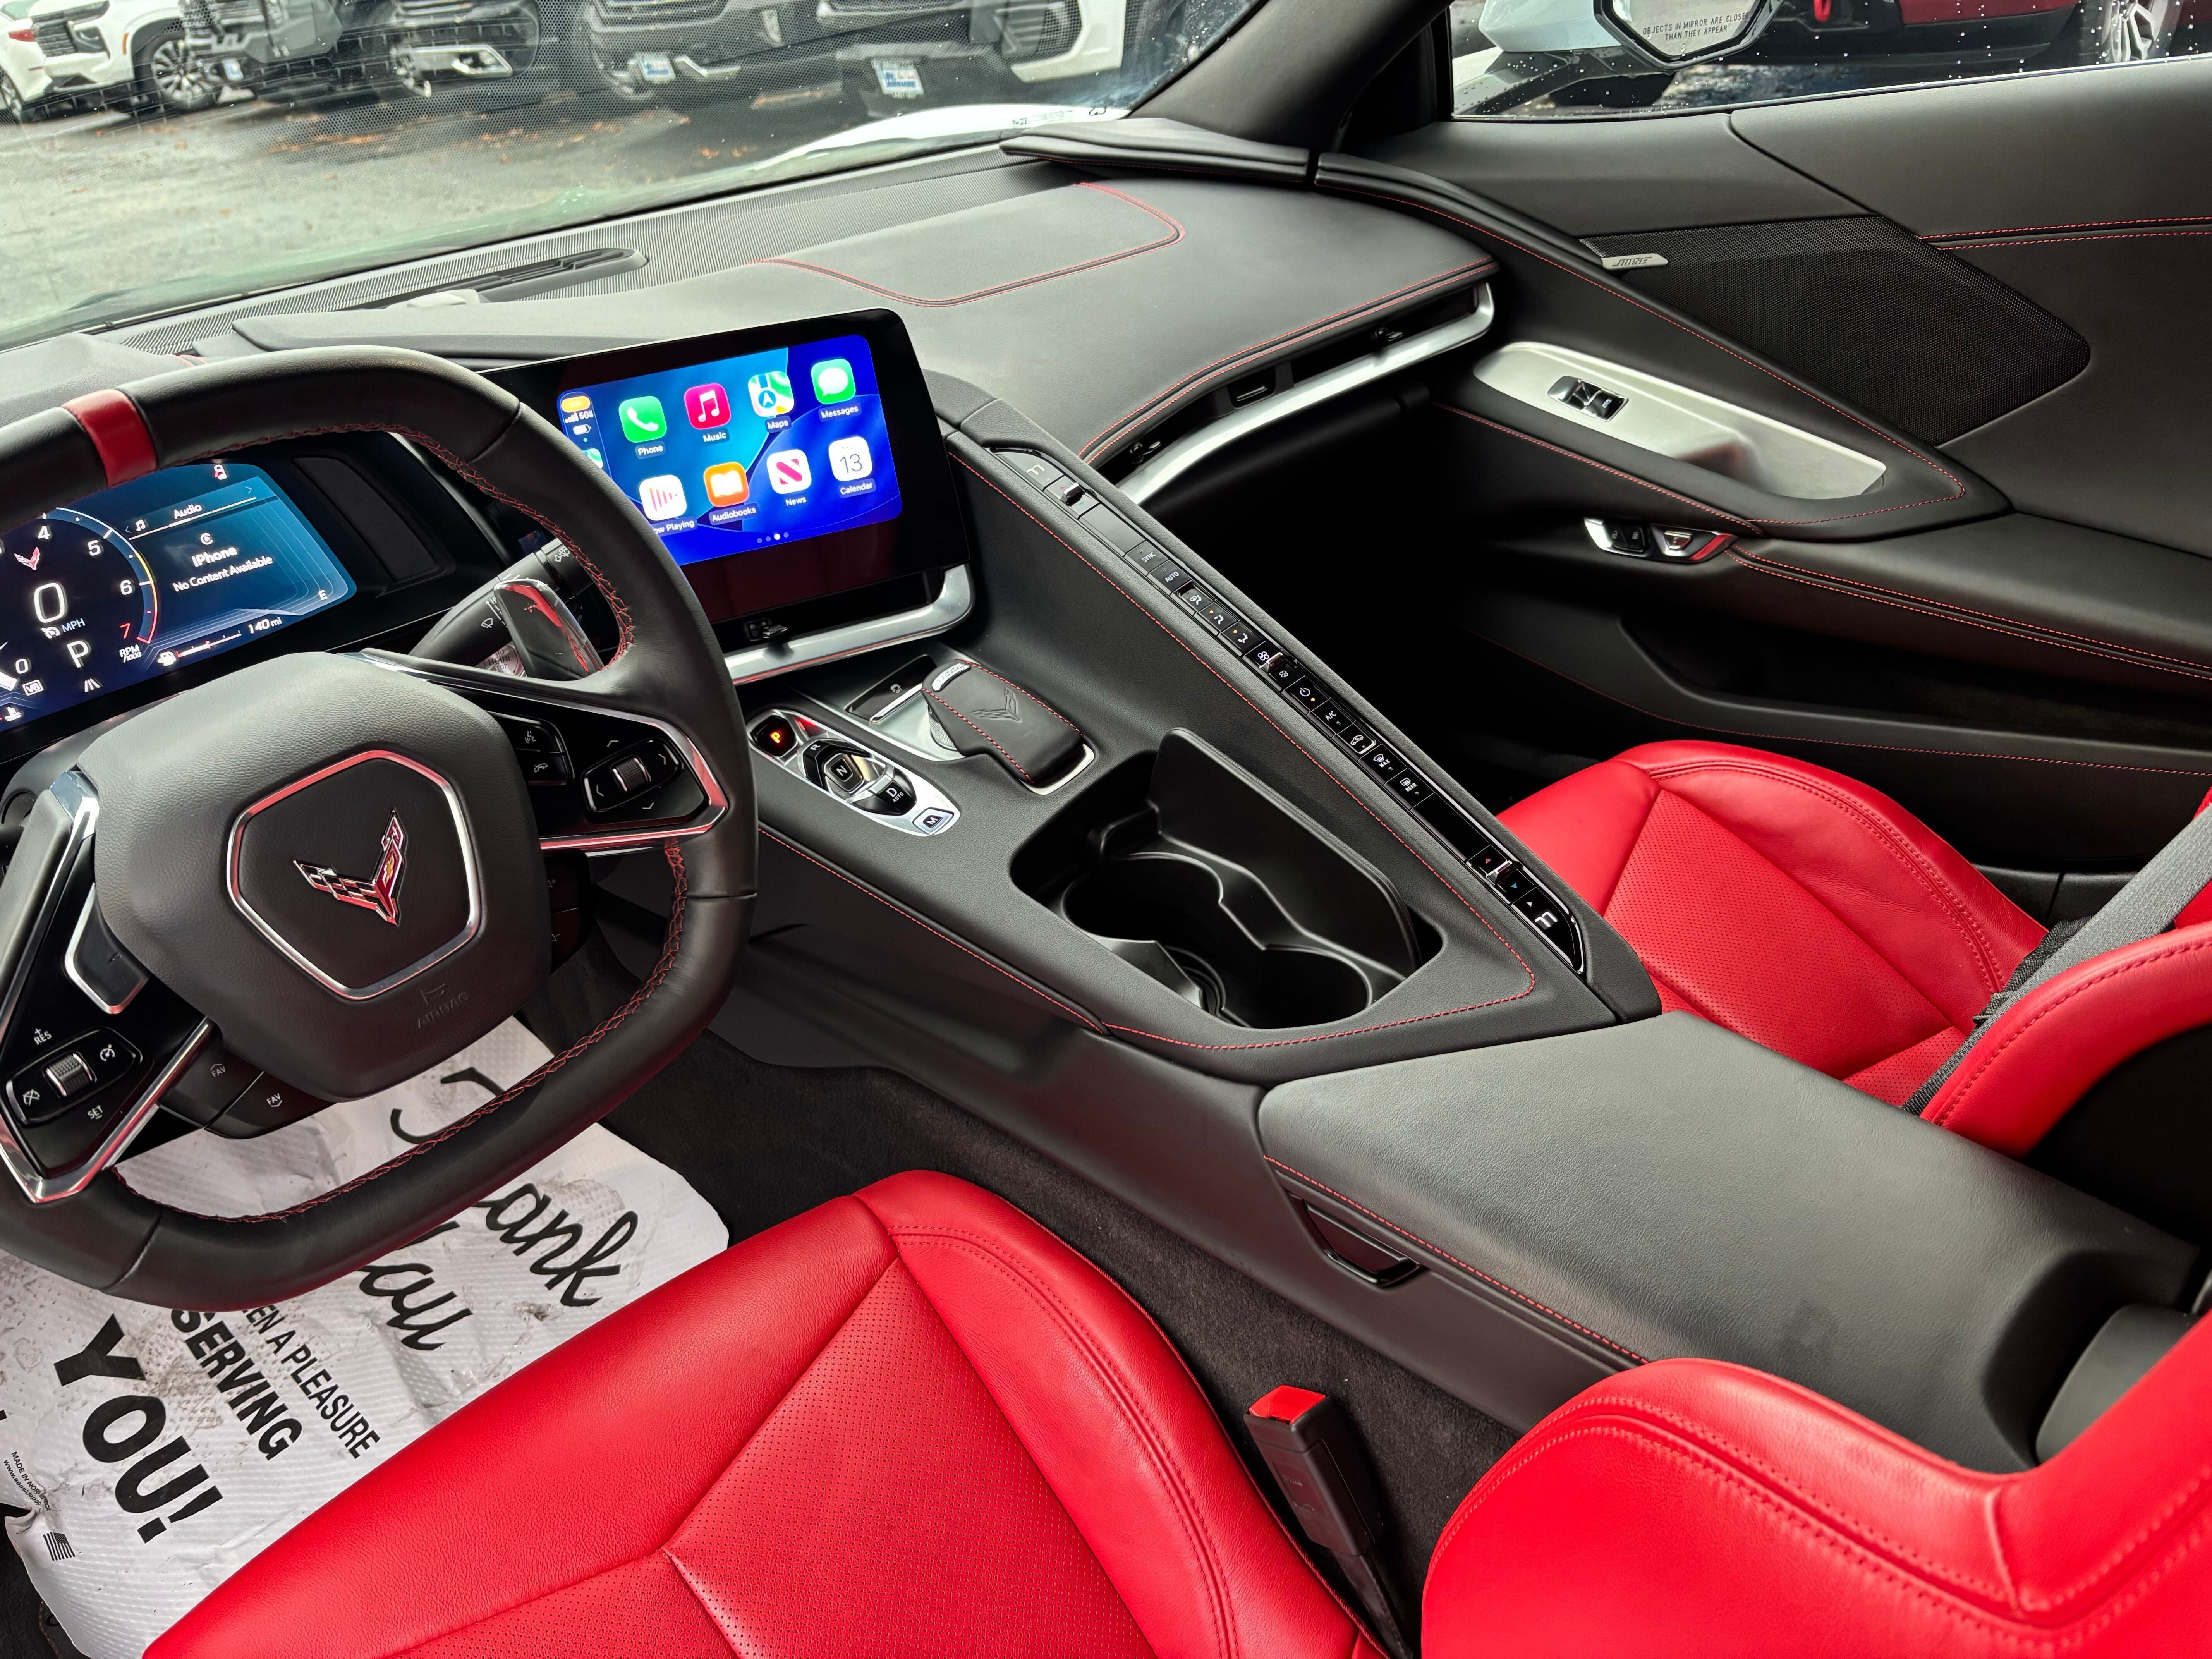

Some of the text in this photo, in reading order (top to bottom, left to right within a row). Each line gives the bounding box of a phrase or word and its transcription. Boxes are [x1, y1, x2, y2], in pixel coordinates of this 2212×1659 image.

[1643, 24, 1672, 35] OBJECTS
[1683, 19, 1707, 29] MIRROR
[1711, 16, 1723, 25] ARE
[1726, 12, 1749, 22] CLOSER
[1665, 25, 1728, 41] THAN THEY APPEAR
[1612, 256, 1652, 267] BOSE
[821, 406, 859, 419] Messages
[767, 419, 789, 429] Maps
[703, 432, 726, 442] Music
[638, 445, 663, 456] Phone
[840, 454, 862, 474] 13
[840, 482, 873, 495] Calendar
[785, 496, 807, 506] News
[174, 505, 202, 519] Audio
[712, 508, 756, 522] Audiobooks
[666, 519, 695, 532] Playing
[38, 526, 50, 539] 4
[88, 540, 101, 556] 5
[192, 547, 237, 567] iPhone
[1141, 551, 1156, 563] SYNC
[173, 556, 273, 592] No Content Available
[1164, 572, 1180, 582] AUTO
[120, 580, 132, 595] 6
[319, 590, 328, 600] E
[34, 582, 65, 623] 0
[61, 618, 86, 632] MPH
[120, 623, 130, 639] 7
[248, 617, 282, 634] 140 mi
[67, 641, 88, 668] P
[119, 644, 140, 658] RPM
[123, 651, 142, 663] /1000
[15, 658, 28, 674] 0
[484, 655, 511, 666] ENGINE
[26, 682, 40, 693] V8
[1325, 711, 1336, 721] A/C
[770, 732, 780, 743] P
[1379, 759, 1390, 768] MAX
[836, 765, 848, 776] N
[886, 788, 897, 797] D
[1405, 783, 1417, 792] REAR
[892, 792, 904, 803] AUTO
[926, 817, 938, 825] M
[417, 992, 469, 1029] AIRBAG
[34, 1031, 52, 1045] RES
[211, 1066, 226, 1077] FAV
[266, 1093, 281, 1105] FAV
[88, 1105, 103, 1120] SET
[267, 1330, 296, 1354] A
[171, 1309, 302, 1461] SERVING
[281, 1344, 381, 1460] PLEASURE
[53, 1313, 223, 1544] YOU!
[12, 1451, 25, 1474] MADE
[22, 1473, 30, 1482] IN
